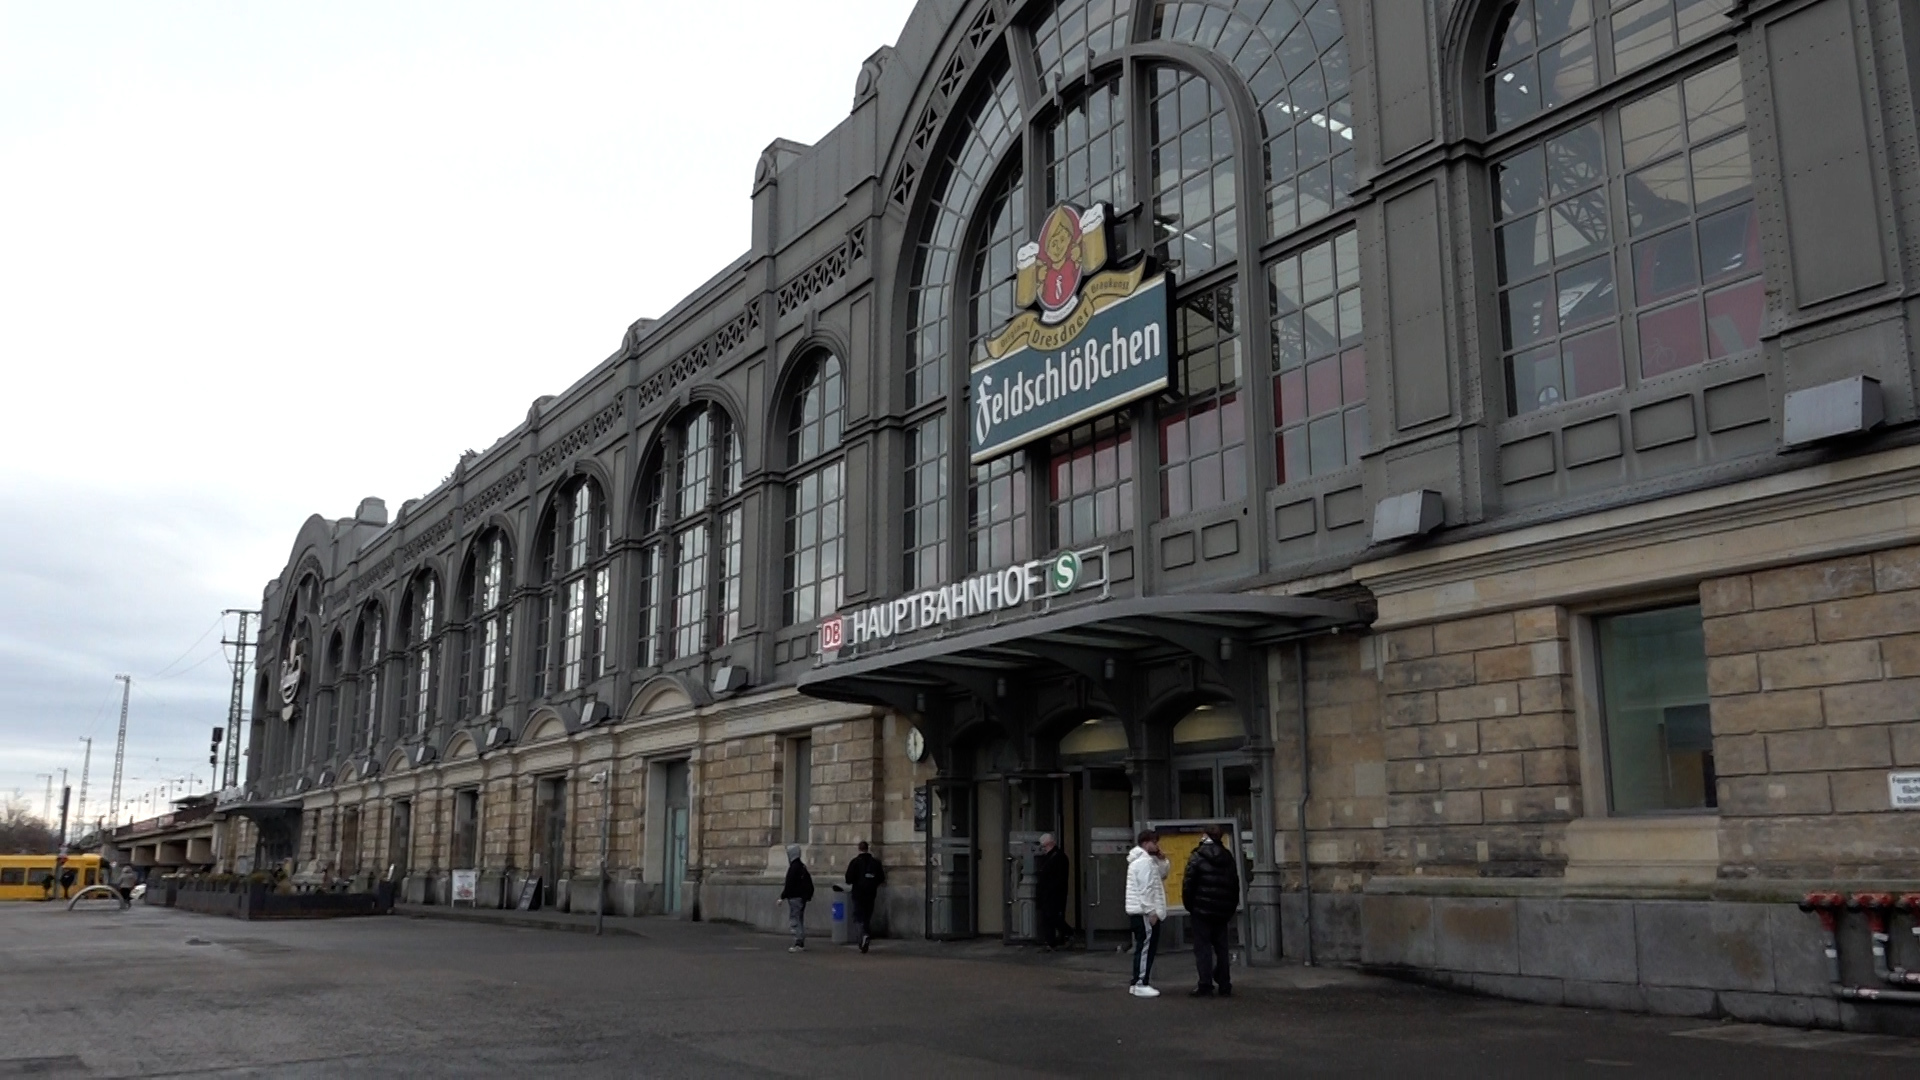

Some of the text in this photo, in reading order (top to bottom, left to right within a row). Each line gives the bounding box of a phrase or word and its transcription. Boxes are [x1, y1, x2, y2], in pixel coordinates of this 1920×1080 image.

[1032, 308, 1090, 346] Dresdner
[977, 322, 1160, 446] Feldschlößchen
[823, 555, 1074, 647] DB HAUPTBAHNHOF S
